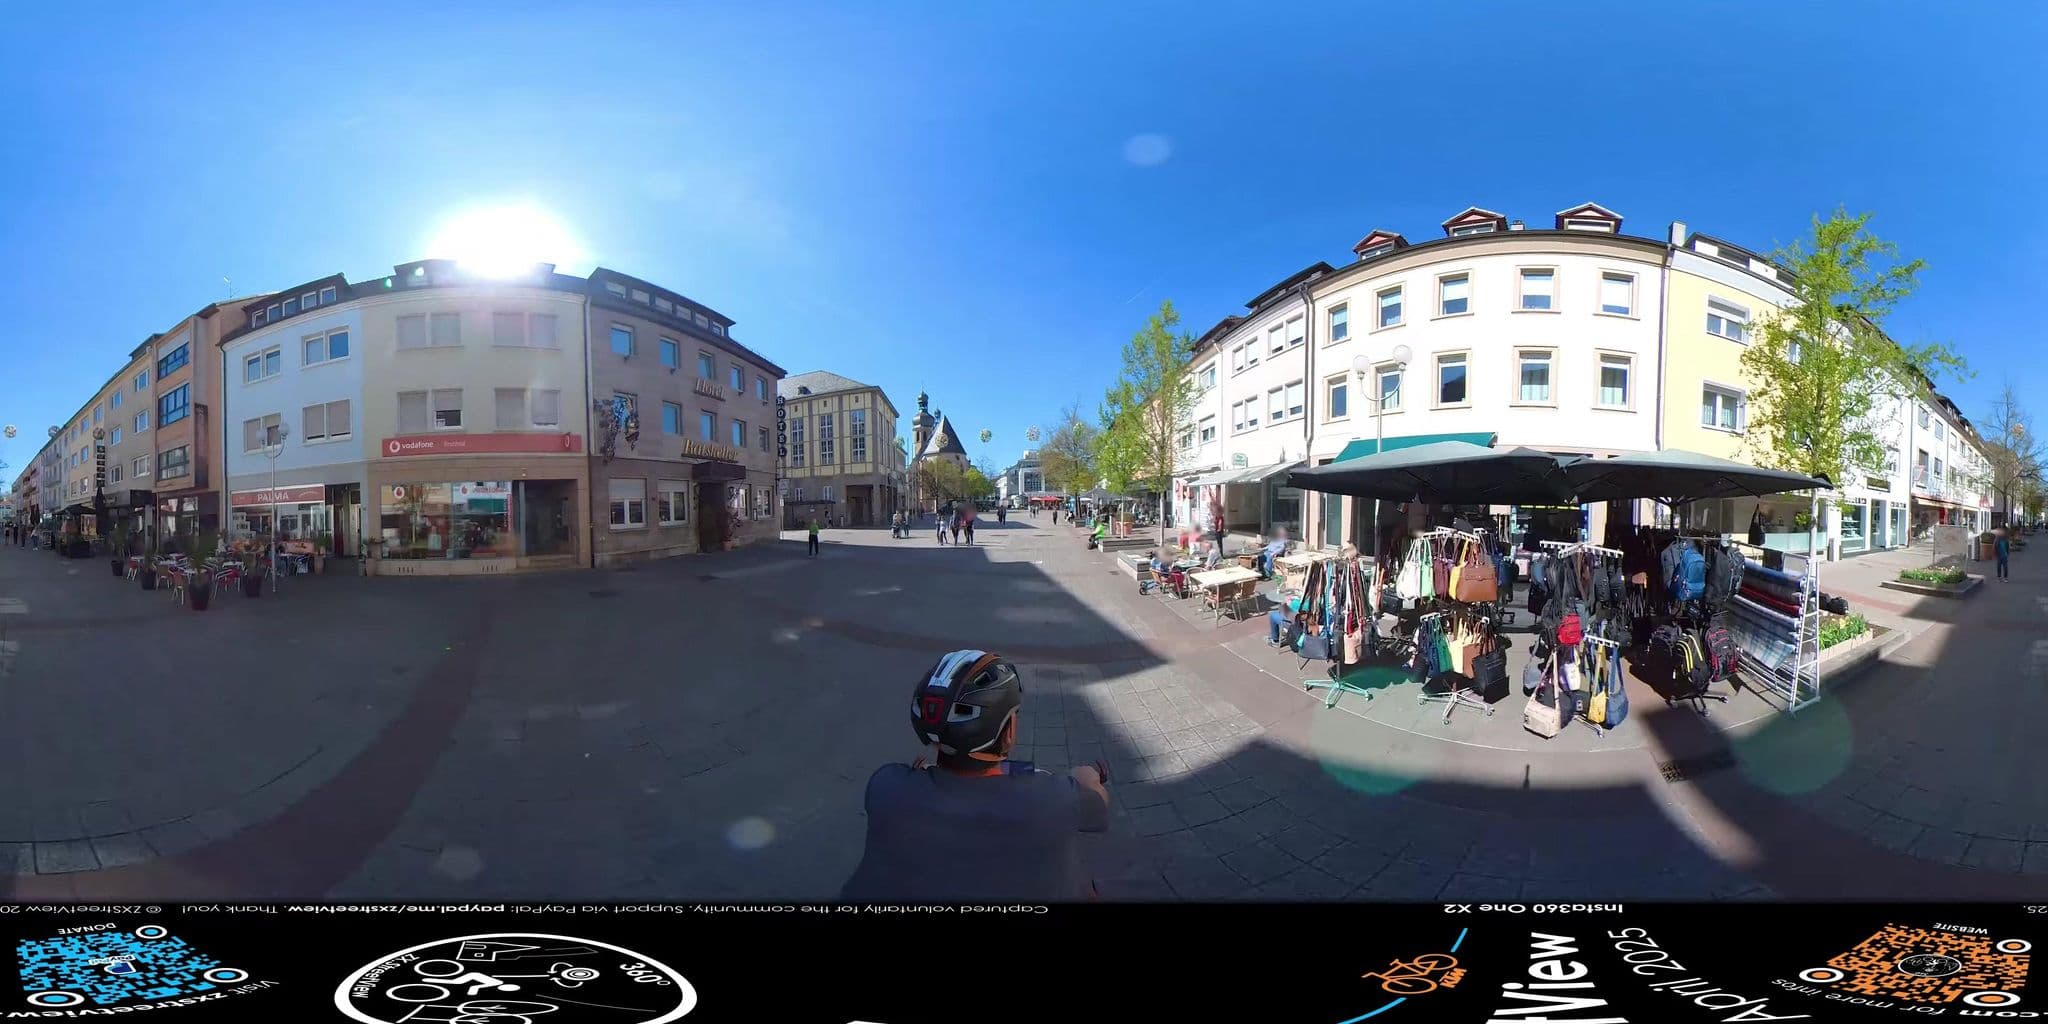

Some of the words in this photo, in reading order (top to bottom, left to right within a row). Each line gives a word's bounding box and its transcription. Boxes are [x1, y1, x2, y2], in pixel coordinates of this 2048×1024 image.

[777, 397, 786, 456] HOTEL
[401, 440, 434, 450] vodafone
[257, 491, 289, 502] PALMA
